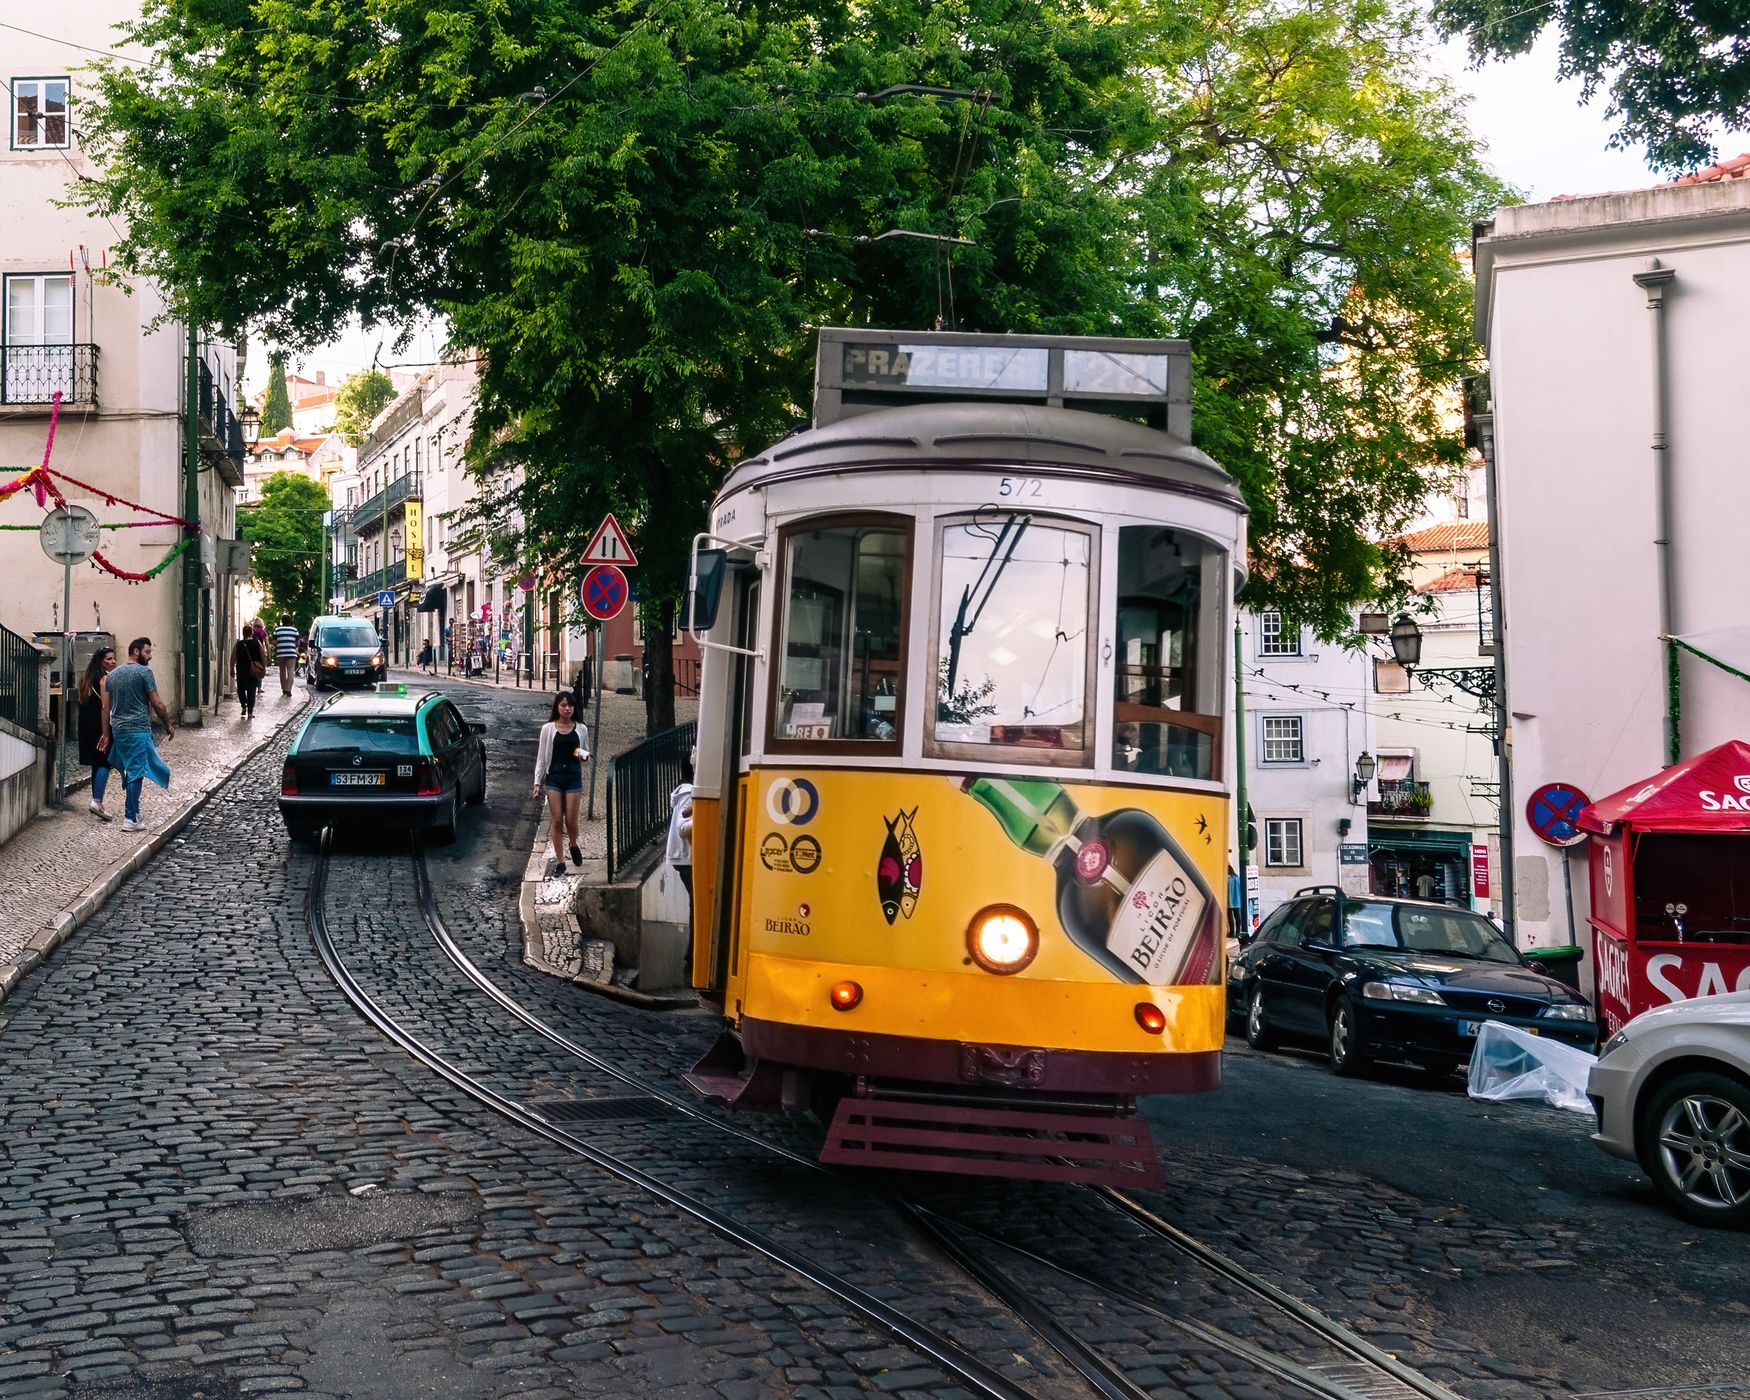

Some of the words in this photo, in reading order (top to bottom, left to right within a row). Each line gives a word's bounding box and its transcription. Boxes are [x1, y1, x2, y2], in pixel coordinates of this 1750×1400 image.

[846, 350, 1024, 379] PRAZERES
[999, 477, 1042, 497] 572
[1130, 877, 1187, 970] BEIRÃO
